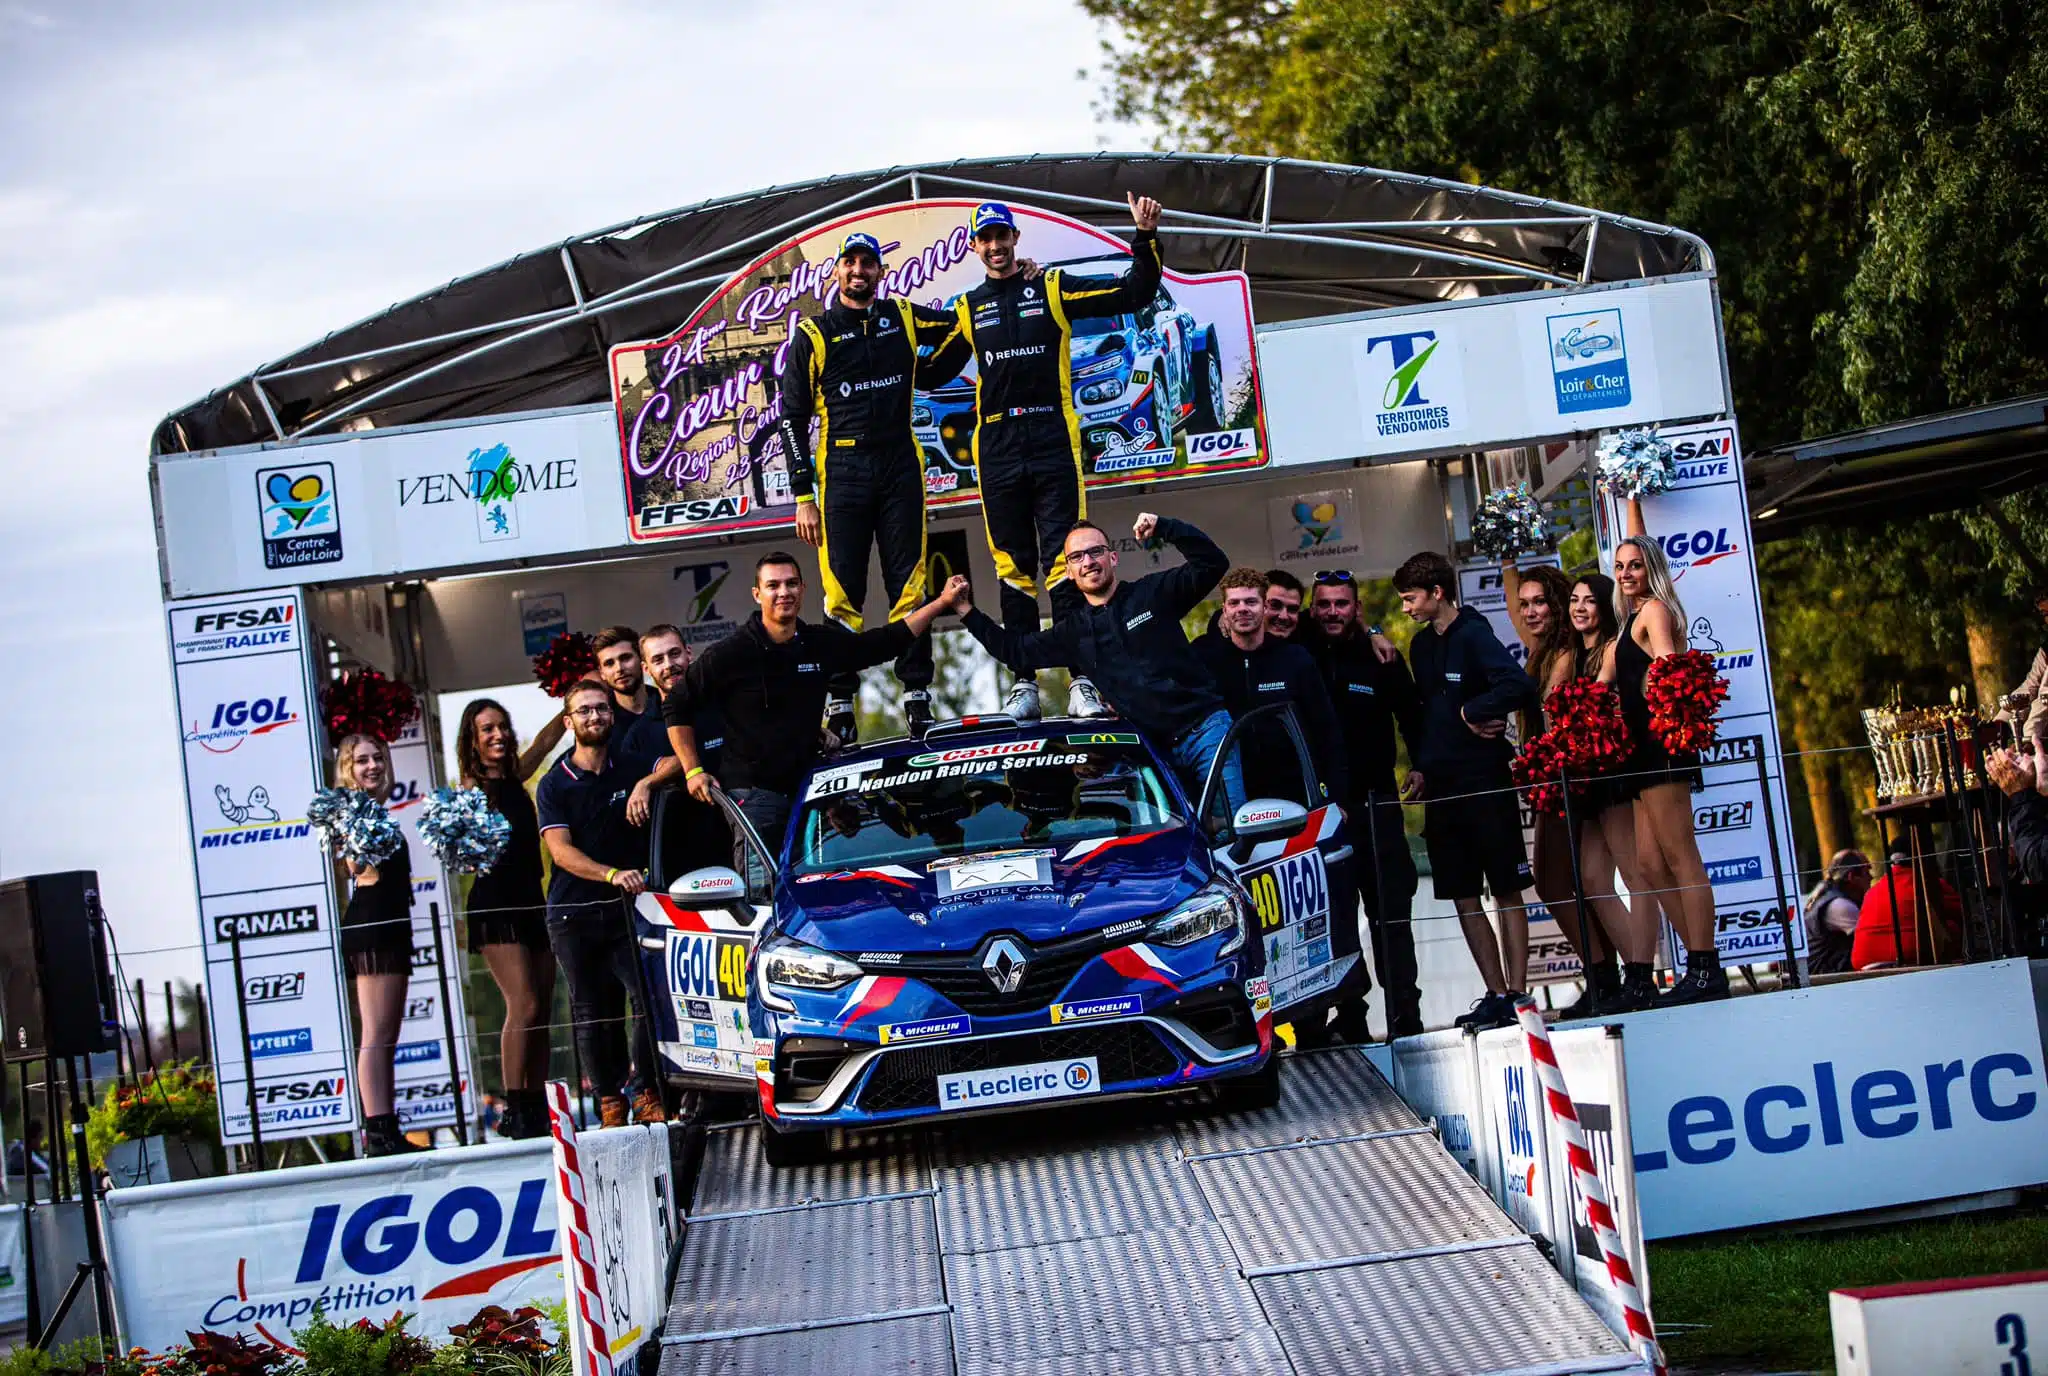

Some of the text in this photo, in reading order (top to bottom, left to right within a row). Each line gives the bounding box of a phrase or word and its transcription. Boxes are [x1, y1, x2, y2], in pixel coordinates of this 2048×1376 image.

[736, 256, 840, 333] Rallye
[1017, 299, 1044, 308] RENAULT
[995, 345, 1047, 361] RENAULT
[855, 374, 903, 392] RENAULT
[1560, 374, 1625, 394] Loir&Cher
[1376, 406, 1448, 424] TERRITOIRES
[1377, 417, 1450, 436] VENDOMOIS
[664, 391, 784, 493] Région Cent
[1673, 441, 1720, 461] SA
[1096, 453, 1172, 471] MICHELIN
[1678, 463, 1728, 482] ALLYE
[397, 458, 577, 507] VENDÔME
[641, 502, 738, 530] FFSA
[287, 538, 331, 551] Centre-
[195, 606, 285, 634] FFSA
[225, 630, 291, 649] RALLYE
[184, 723, 248, 744] Compétition
[943, 741, 1040, 763] Castrol
[858, 751, 1087, 793] Naudon Rallye Services
[814, 777, 849, 796] 40
[1249, 809, 1281, 823] Castrol
[201, 824, 310, 849] MICHELIN
[701, 877, 734, 891] Castrol
[1251, 853, 1327, 929] 40 IGOL
[939, 885, 1056, 906] GROUPE CAA
[218, 911, 316, 937] CANAL+
[1102, 919, 1142, 935] NAUDON
[1728, 931, 1784, 950] RALLY
[859, 952, 903, 960] NAUDON
[670, 935, 746, 998] IGOL 40
[1077, 1000, 1131, 1016] MICHELIN
[905, 1019, 959, 1036] MICHELIN
[945, 1072, 1058, 1102] E.Leclerc
[276, 1103, 342, 1122] RALLYE
[203, 1283, 415, 1328] Compétition
[1994, 1313, 2031, 1376] 3
